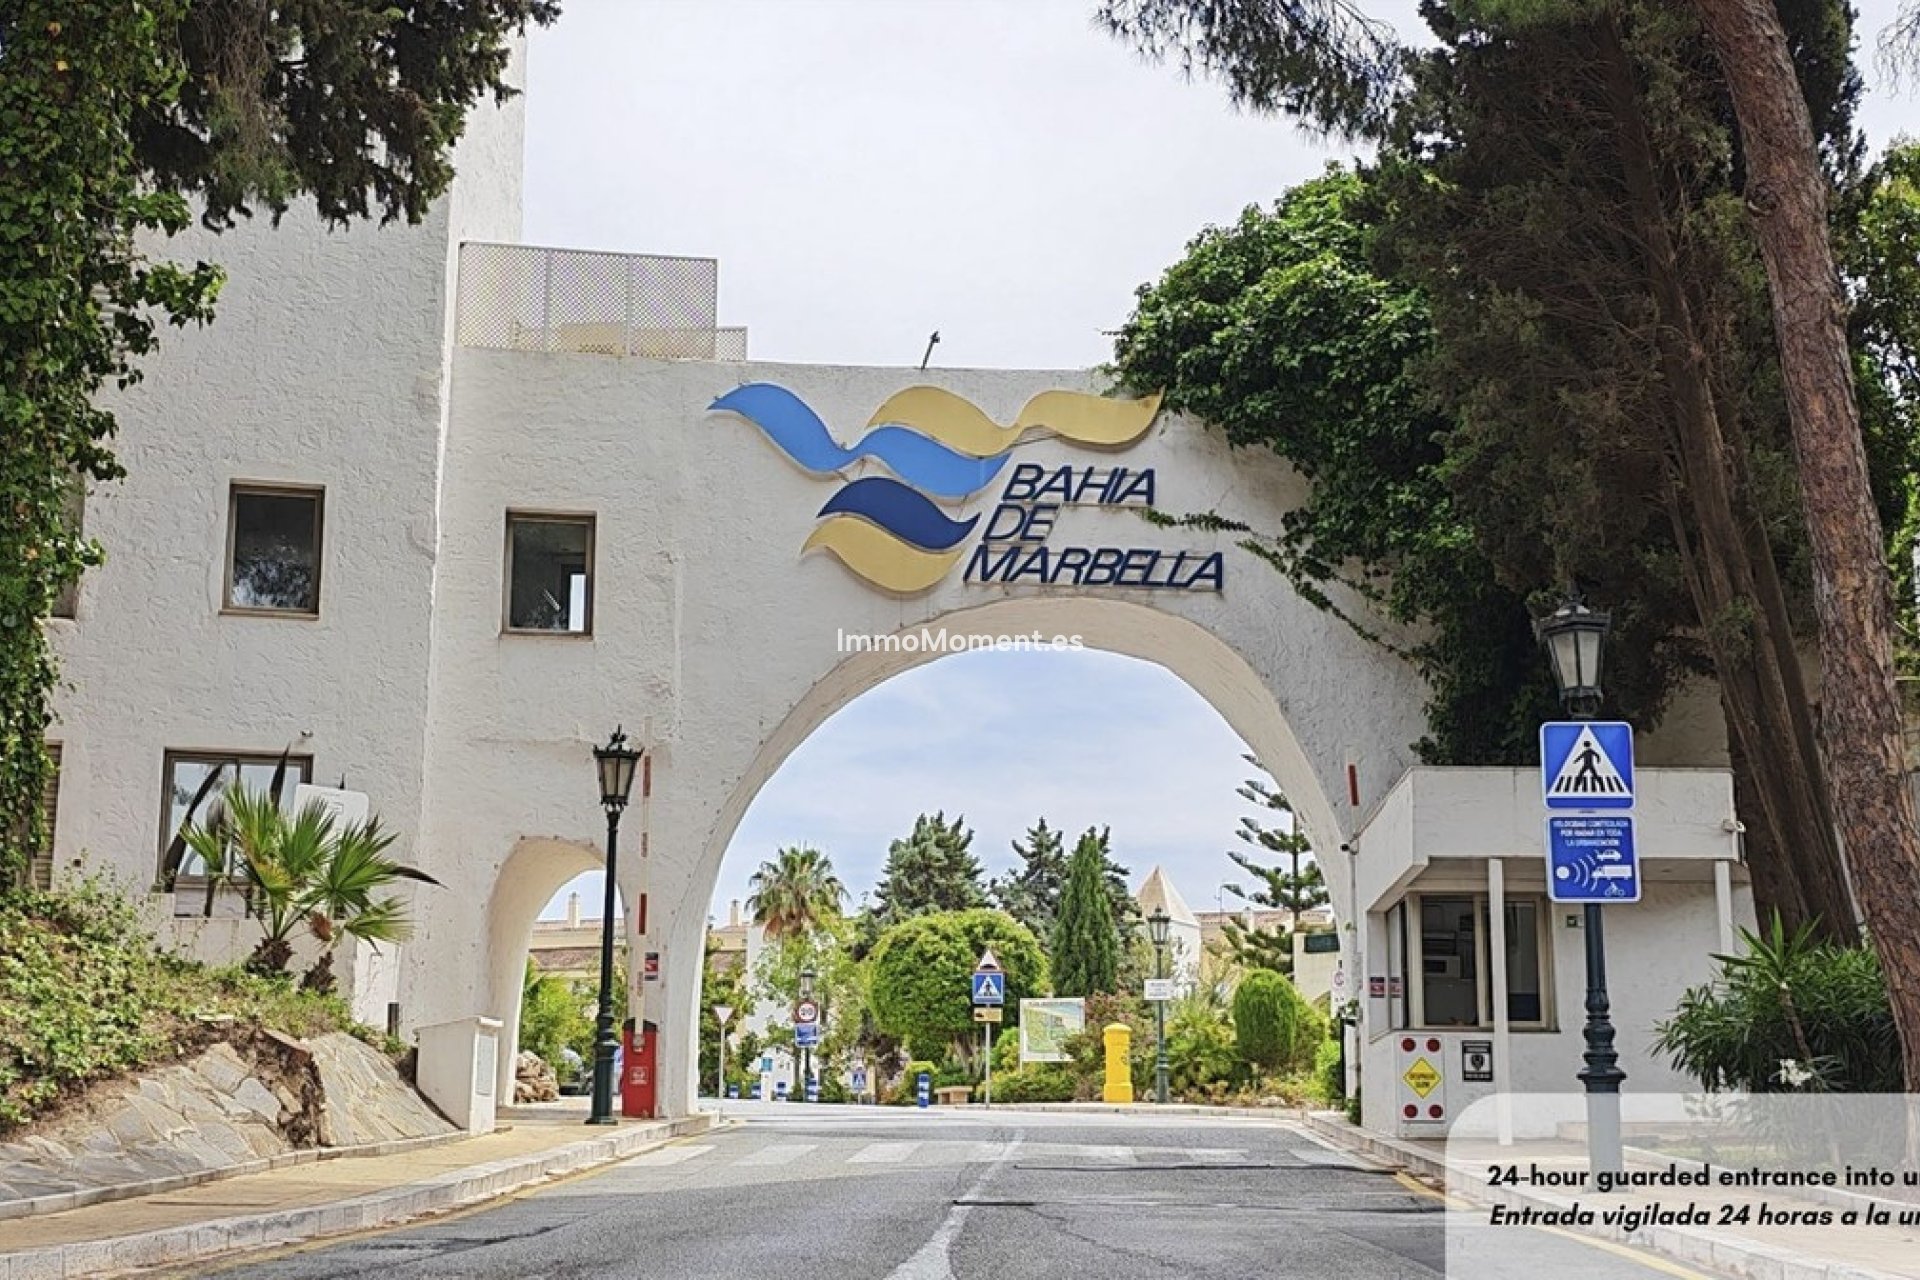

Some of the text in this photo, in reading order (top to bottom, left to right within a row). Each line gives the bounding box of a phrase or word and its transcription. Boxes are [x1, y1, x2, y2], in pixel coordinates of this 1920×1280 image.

[1002, 463, 1156, 506] BAHIA
[982, 503, 1060, 542] DE
[963, 545, 1225, 591] MARBELLA
